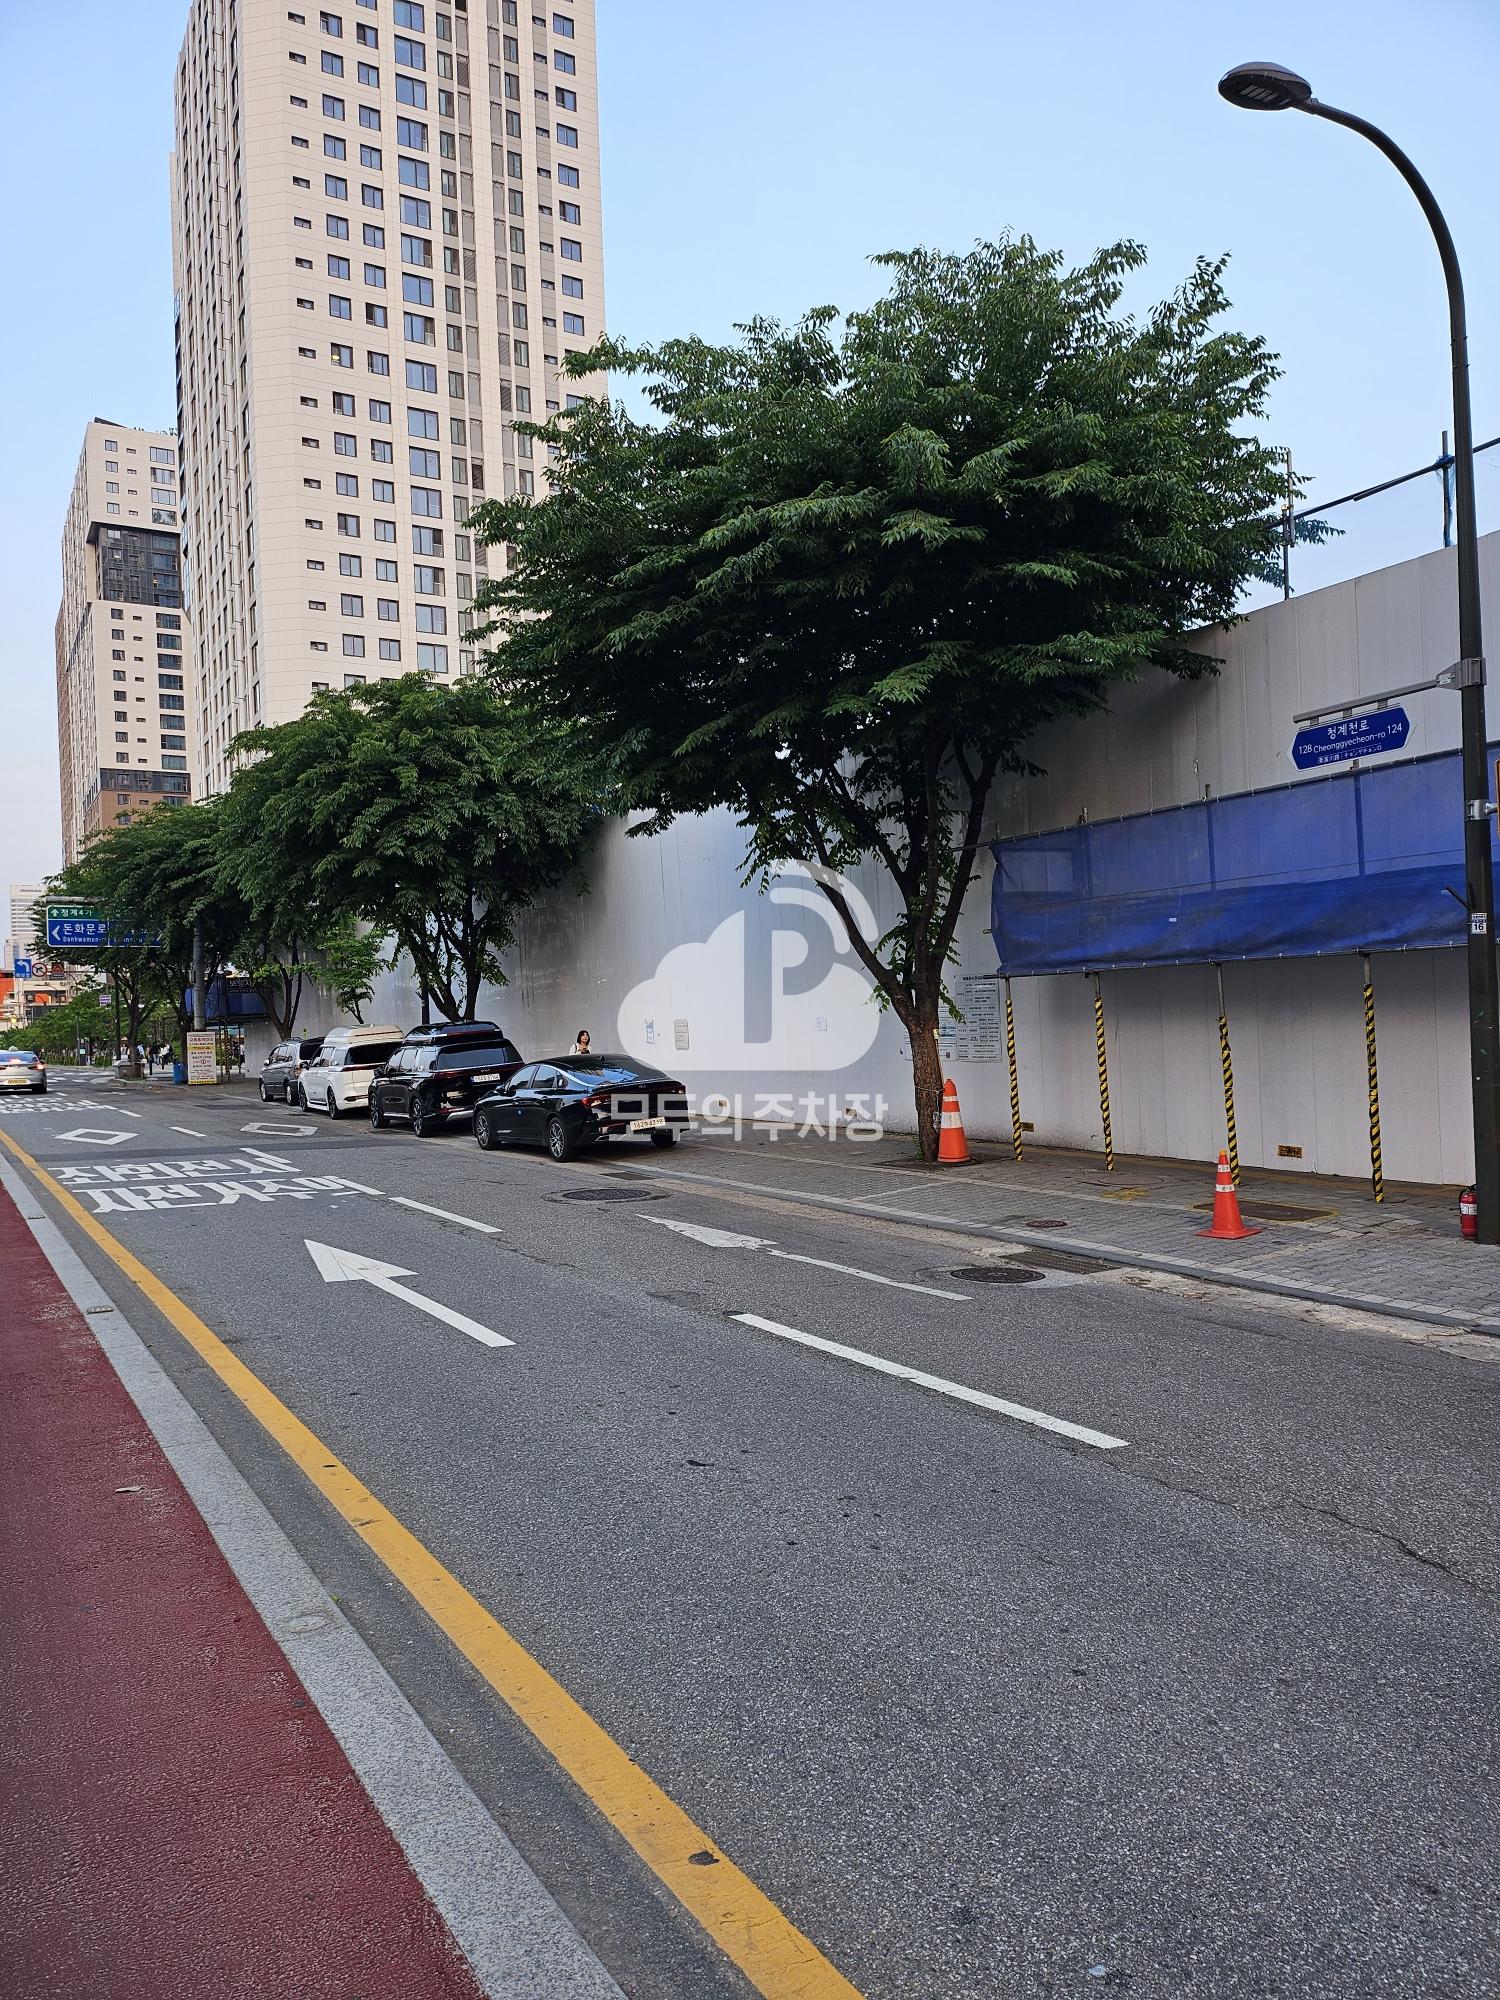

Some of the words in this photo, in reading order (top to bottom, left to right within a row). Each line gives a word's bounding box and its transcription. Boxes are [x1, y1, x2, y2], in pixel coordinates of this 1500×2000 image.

[1298, 744, 1313, 755] 128
[1313, 731, 1386, 753] Cheonggyecheon-ro
[1387, 722, 1403, 735] 124
[1327, 719, 1370, 740] 청계천로
[63, 923, 107, 935] 돈화문로
[1475, 923, 1484, 931] 16
[47, 1157, 303, 1184] 좌회전시
[73, 1175, 386, 1213] 자전거주의
